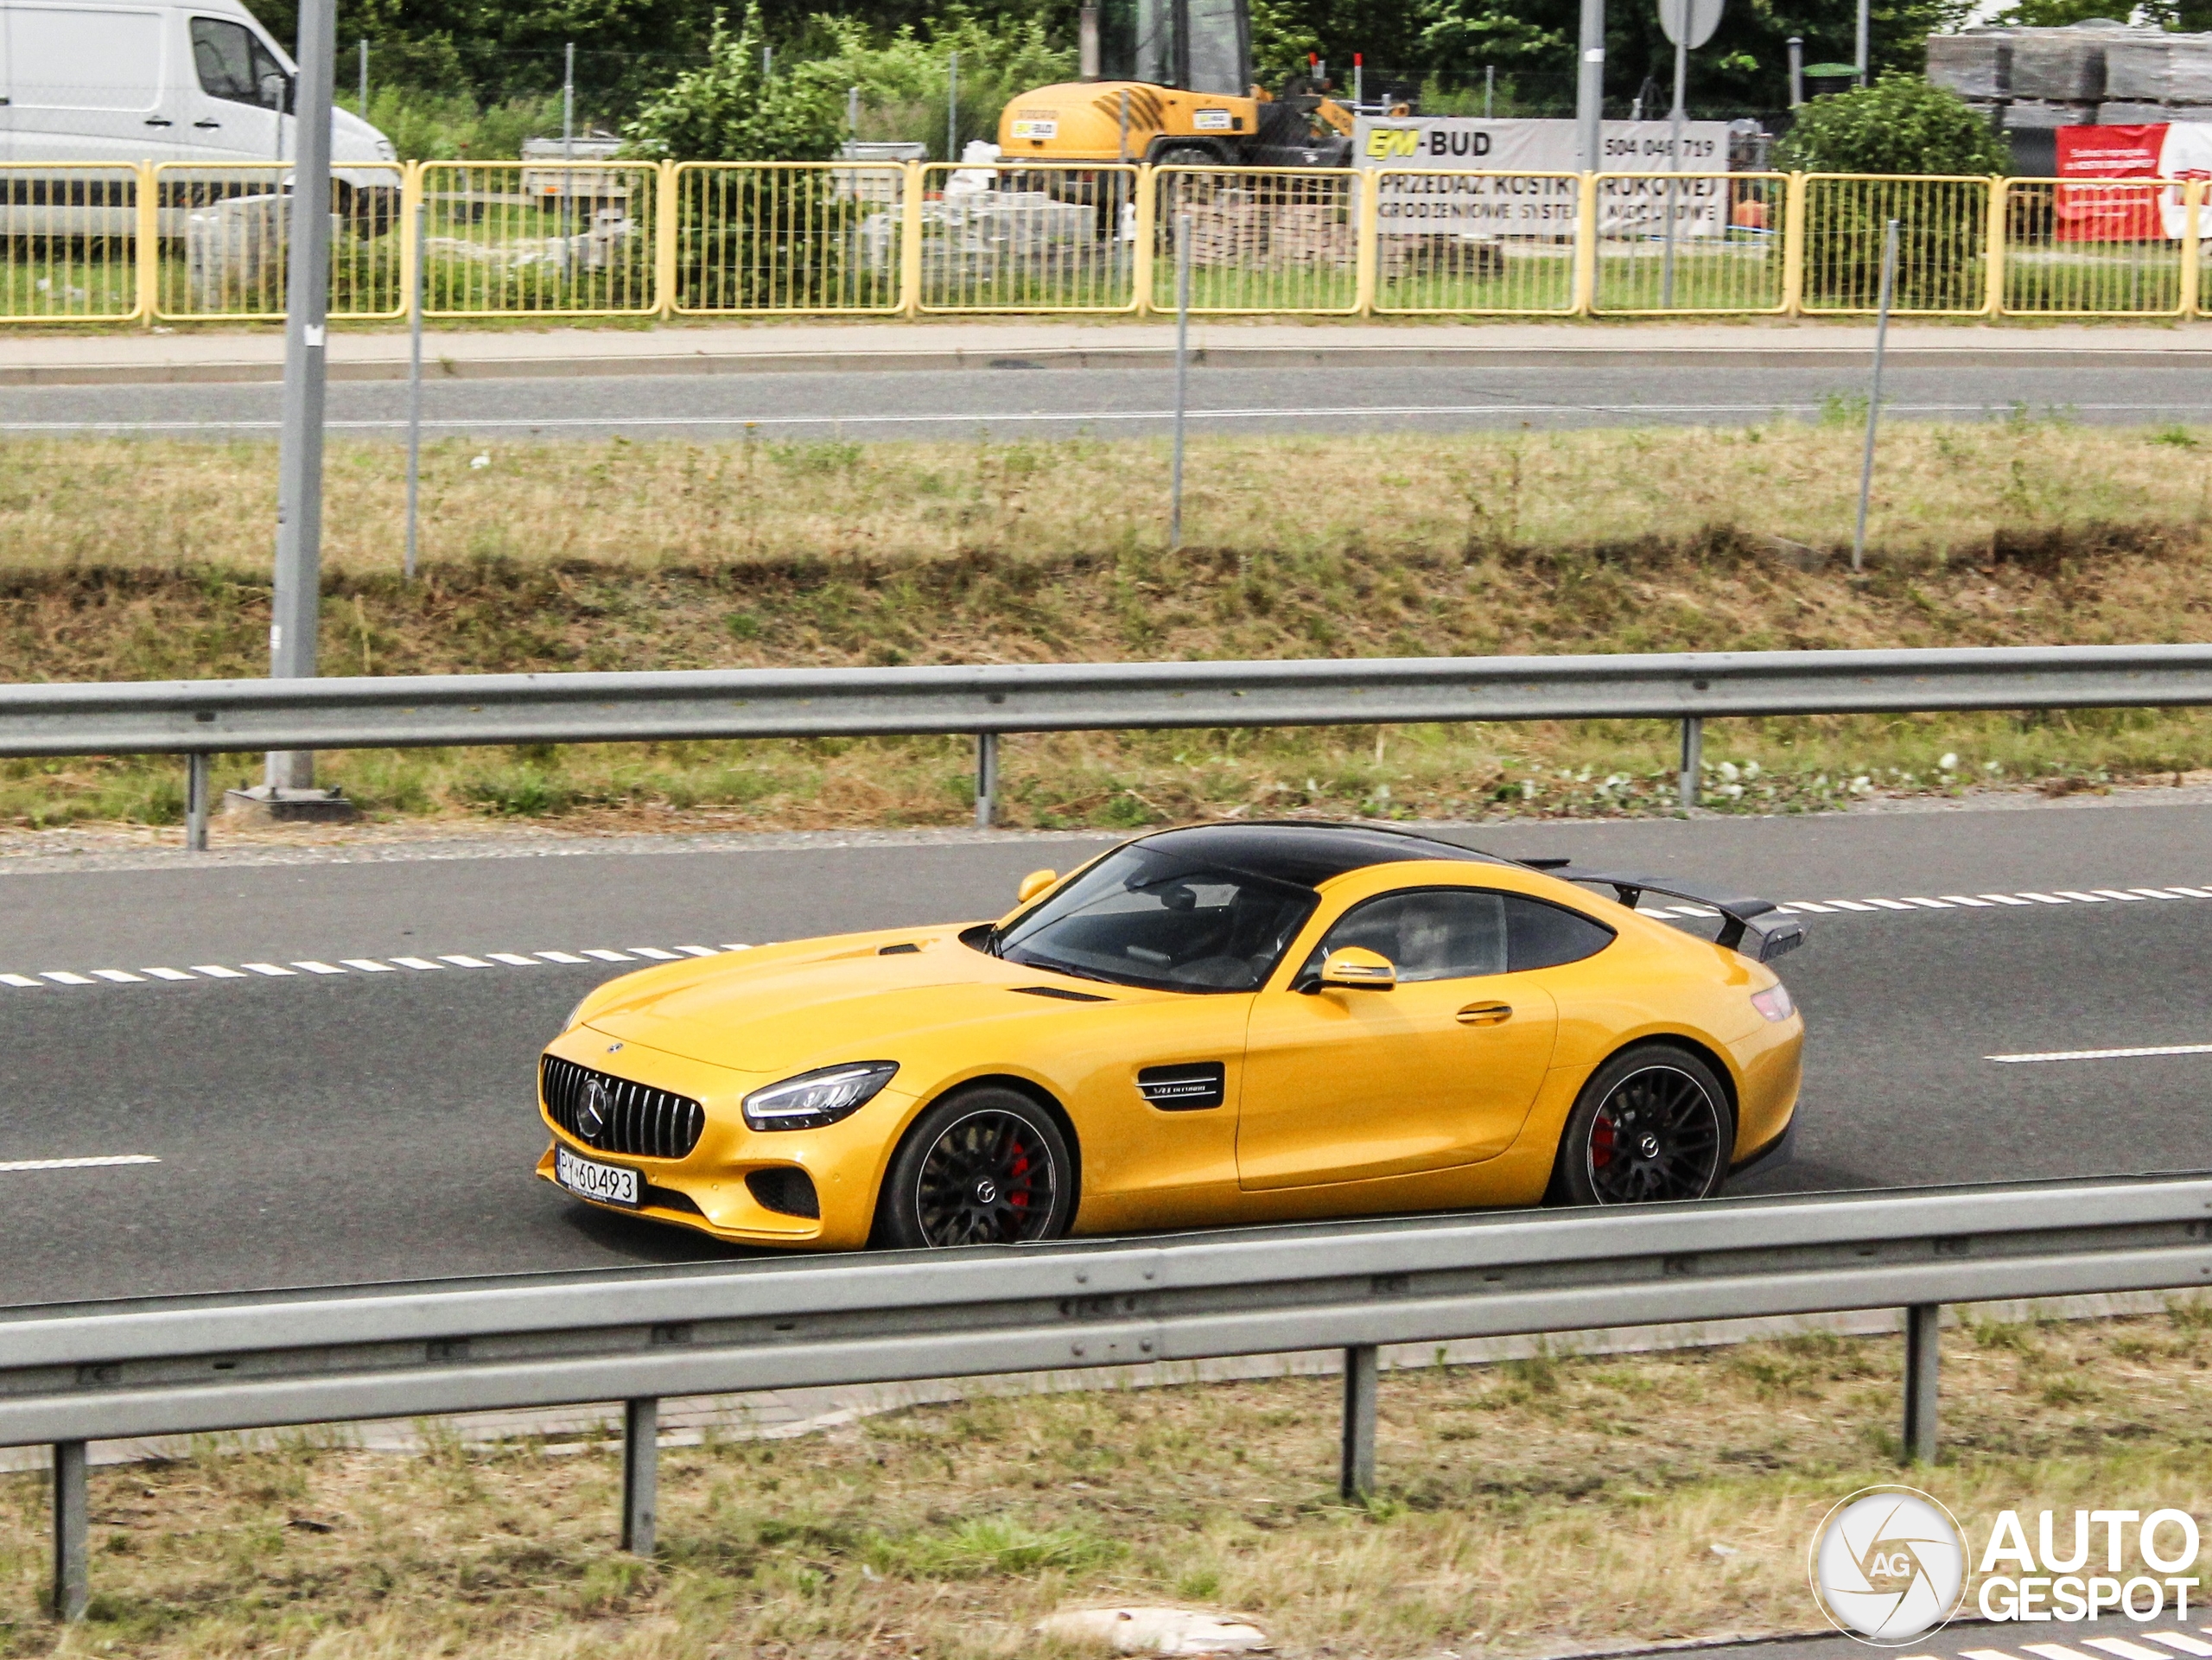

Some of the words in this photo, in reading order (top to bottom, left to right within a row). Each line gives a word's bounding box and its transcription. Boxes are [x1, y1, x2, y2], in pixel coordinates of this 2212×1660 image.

[1366, 129, 1491, 160] EM-BUD
[1605, 139, 1637, 156] 504
[1683, 140, 1715, 156] 719
[1493, 174, 1571, 194] KOSTK
[1377, 202, 1511, 219] GRODZENIOWE
[579, 1163, 632, 1199] 60493
